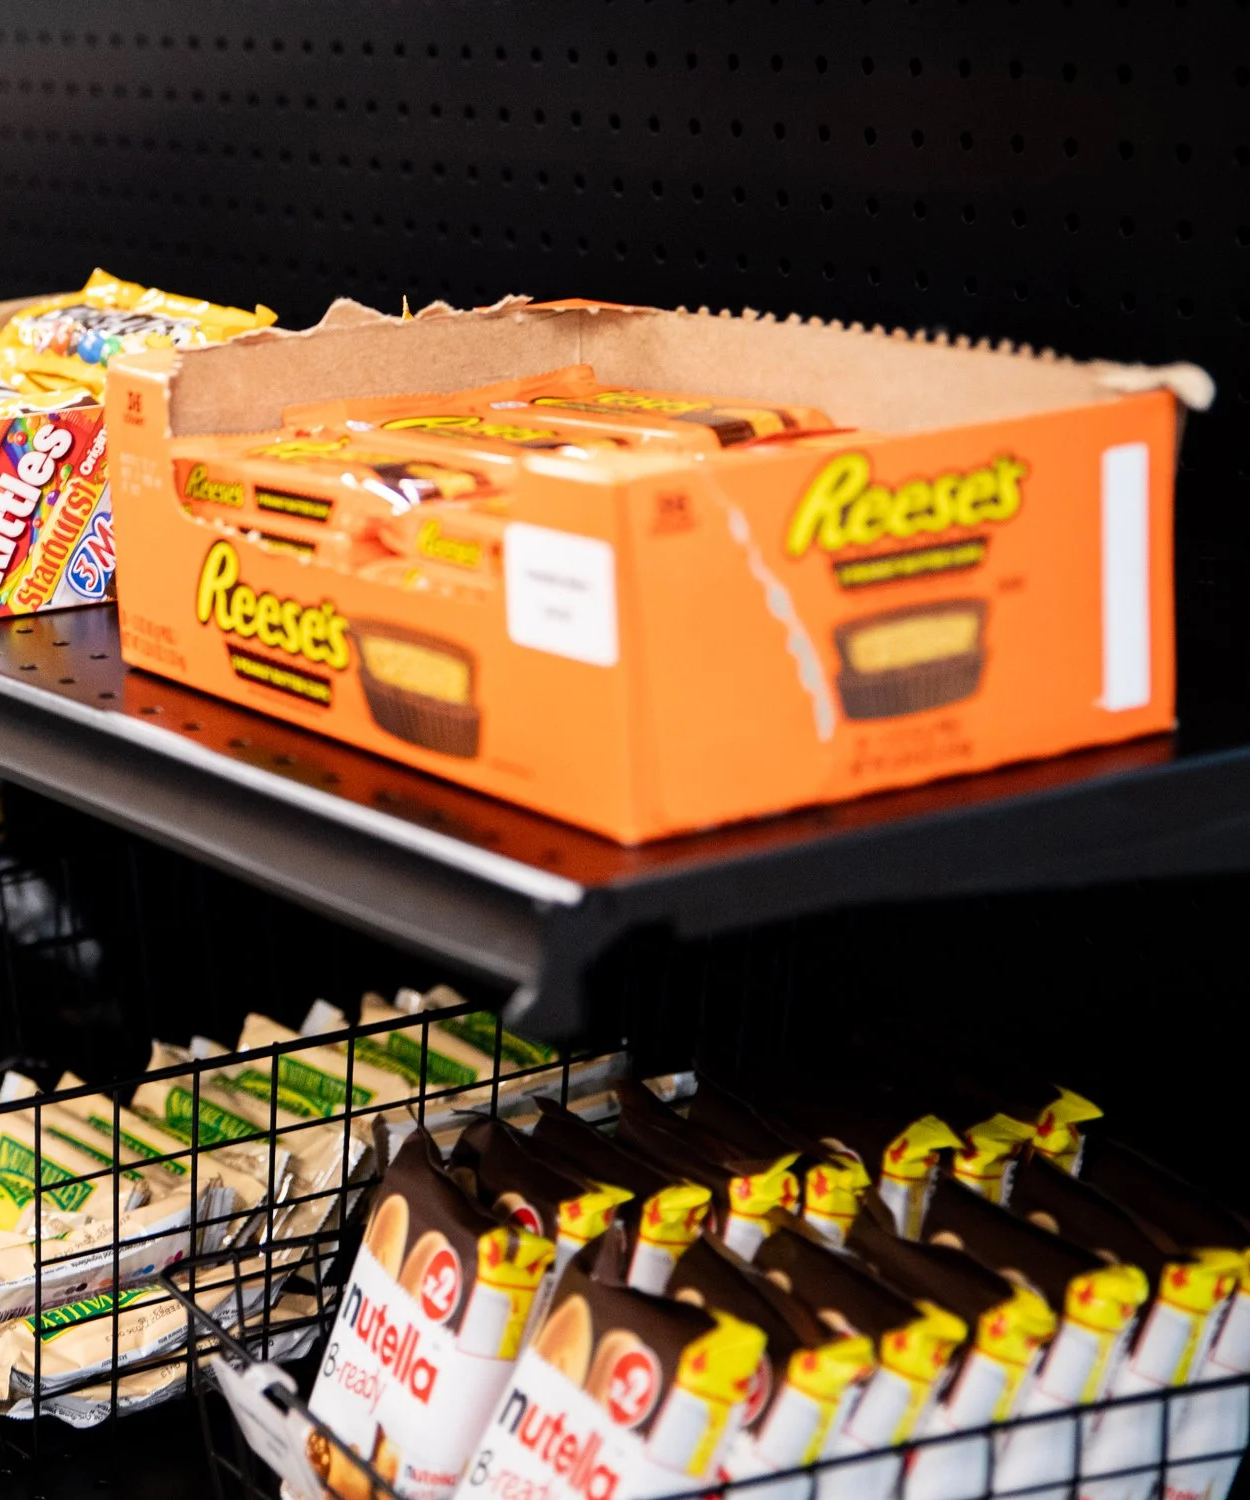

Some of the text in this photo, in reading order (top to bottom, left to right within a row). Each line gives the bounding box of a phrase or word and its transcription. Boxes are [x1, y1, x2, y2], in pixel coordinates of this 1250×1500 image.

[16, 477, 98, 611] Starburst
[785, 452, 1028, 558] Reese's
[196, 539, 349, 671] Reese's
[343, 1283, 439, 1405] nutella
[422, 1266, 456, 1312] x2
[323, 1342, 387, 1415] B-ready
[498, 1387, 620, 1500] nutella
